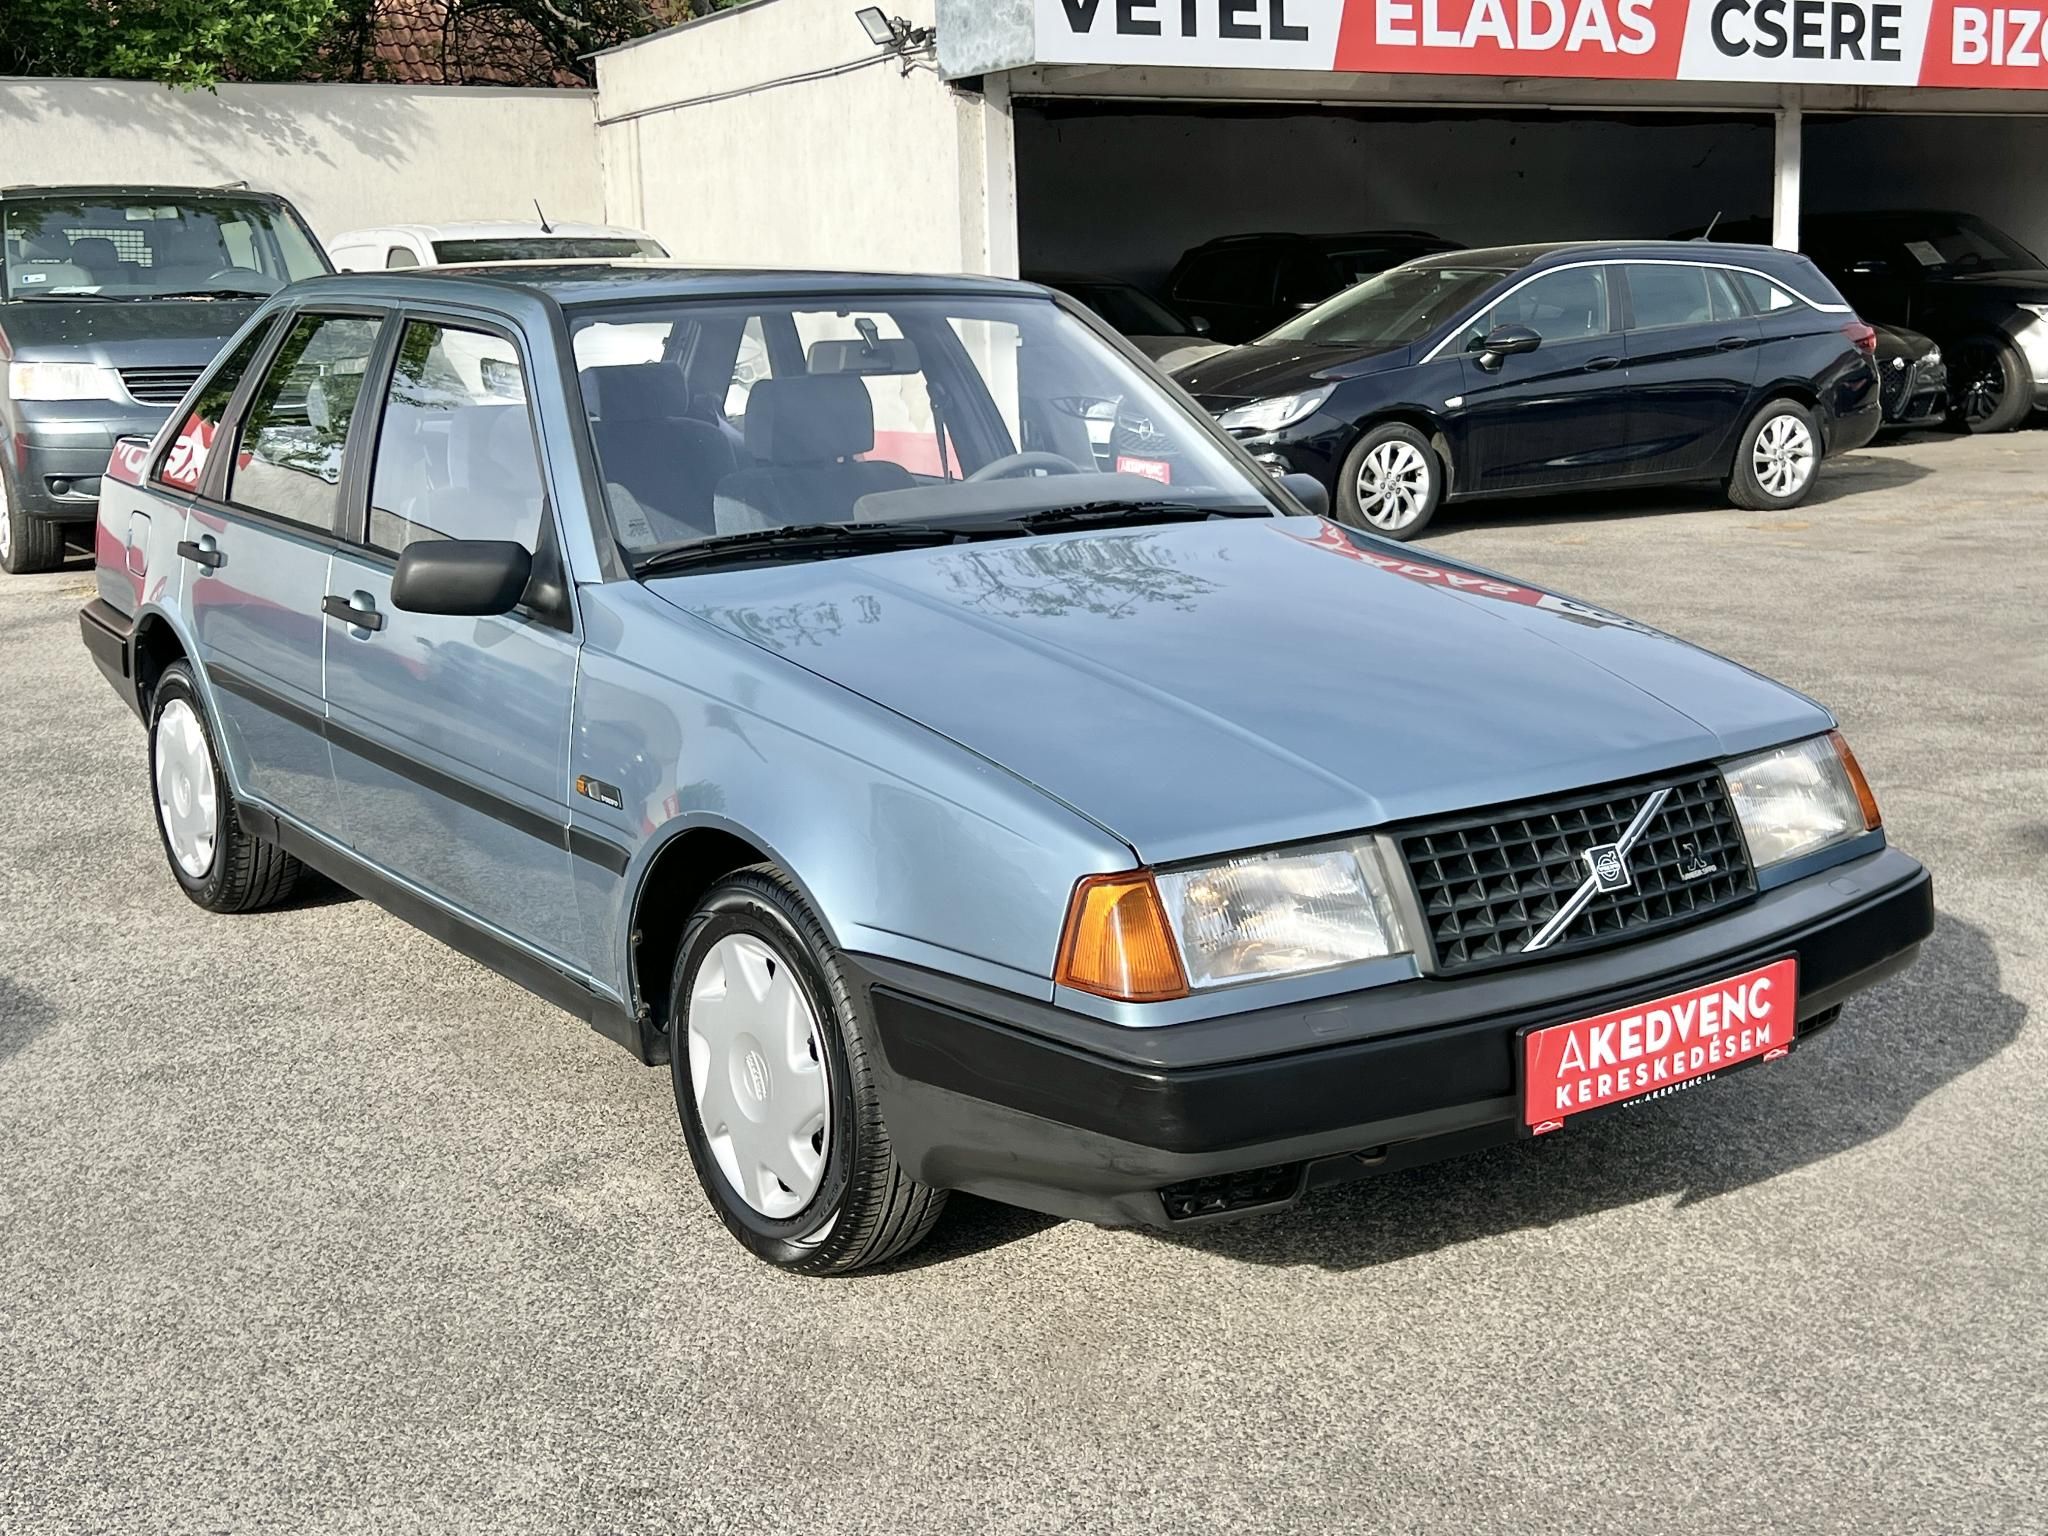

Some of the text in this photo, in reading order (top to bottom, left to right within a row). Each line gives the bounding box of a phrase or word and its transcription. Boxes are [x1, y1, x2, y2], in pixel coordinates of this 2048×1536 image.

[1711, 0, 1901, 61] CSERE
[1952, 7, 2048, 67] BIZ
[1556, 1023, 1771, 1109] KERESKEDÉSEM
